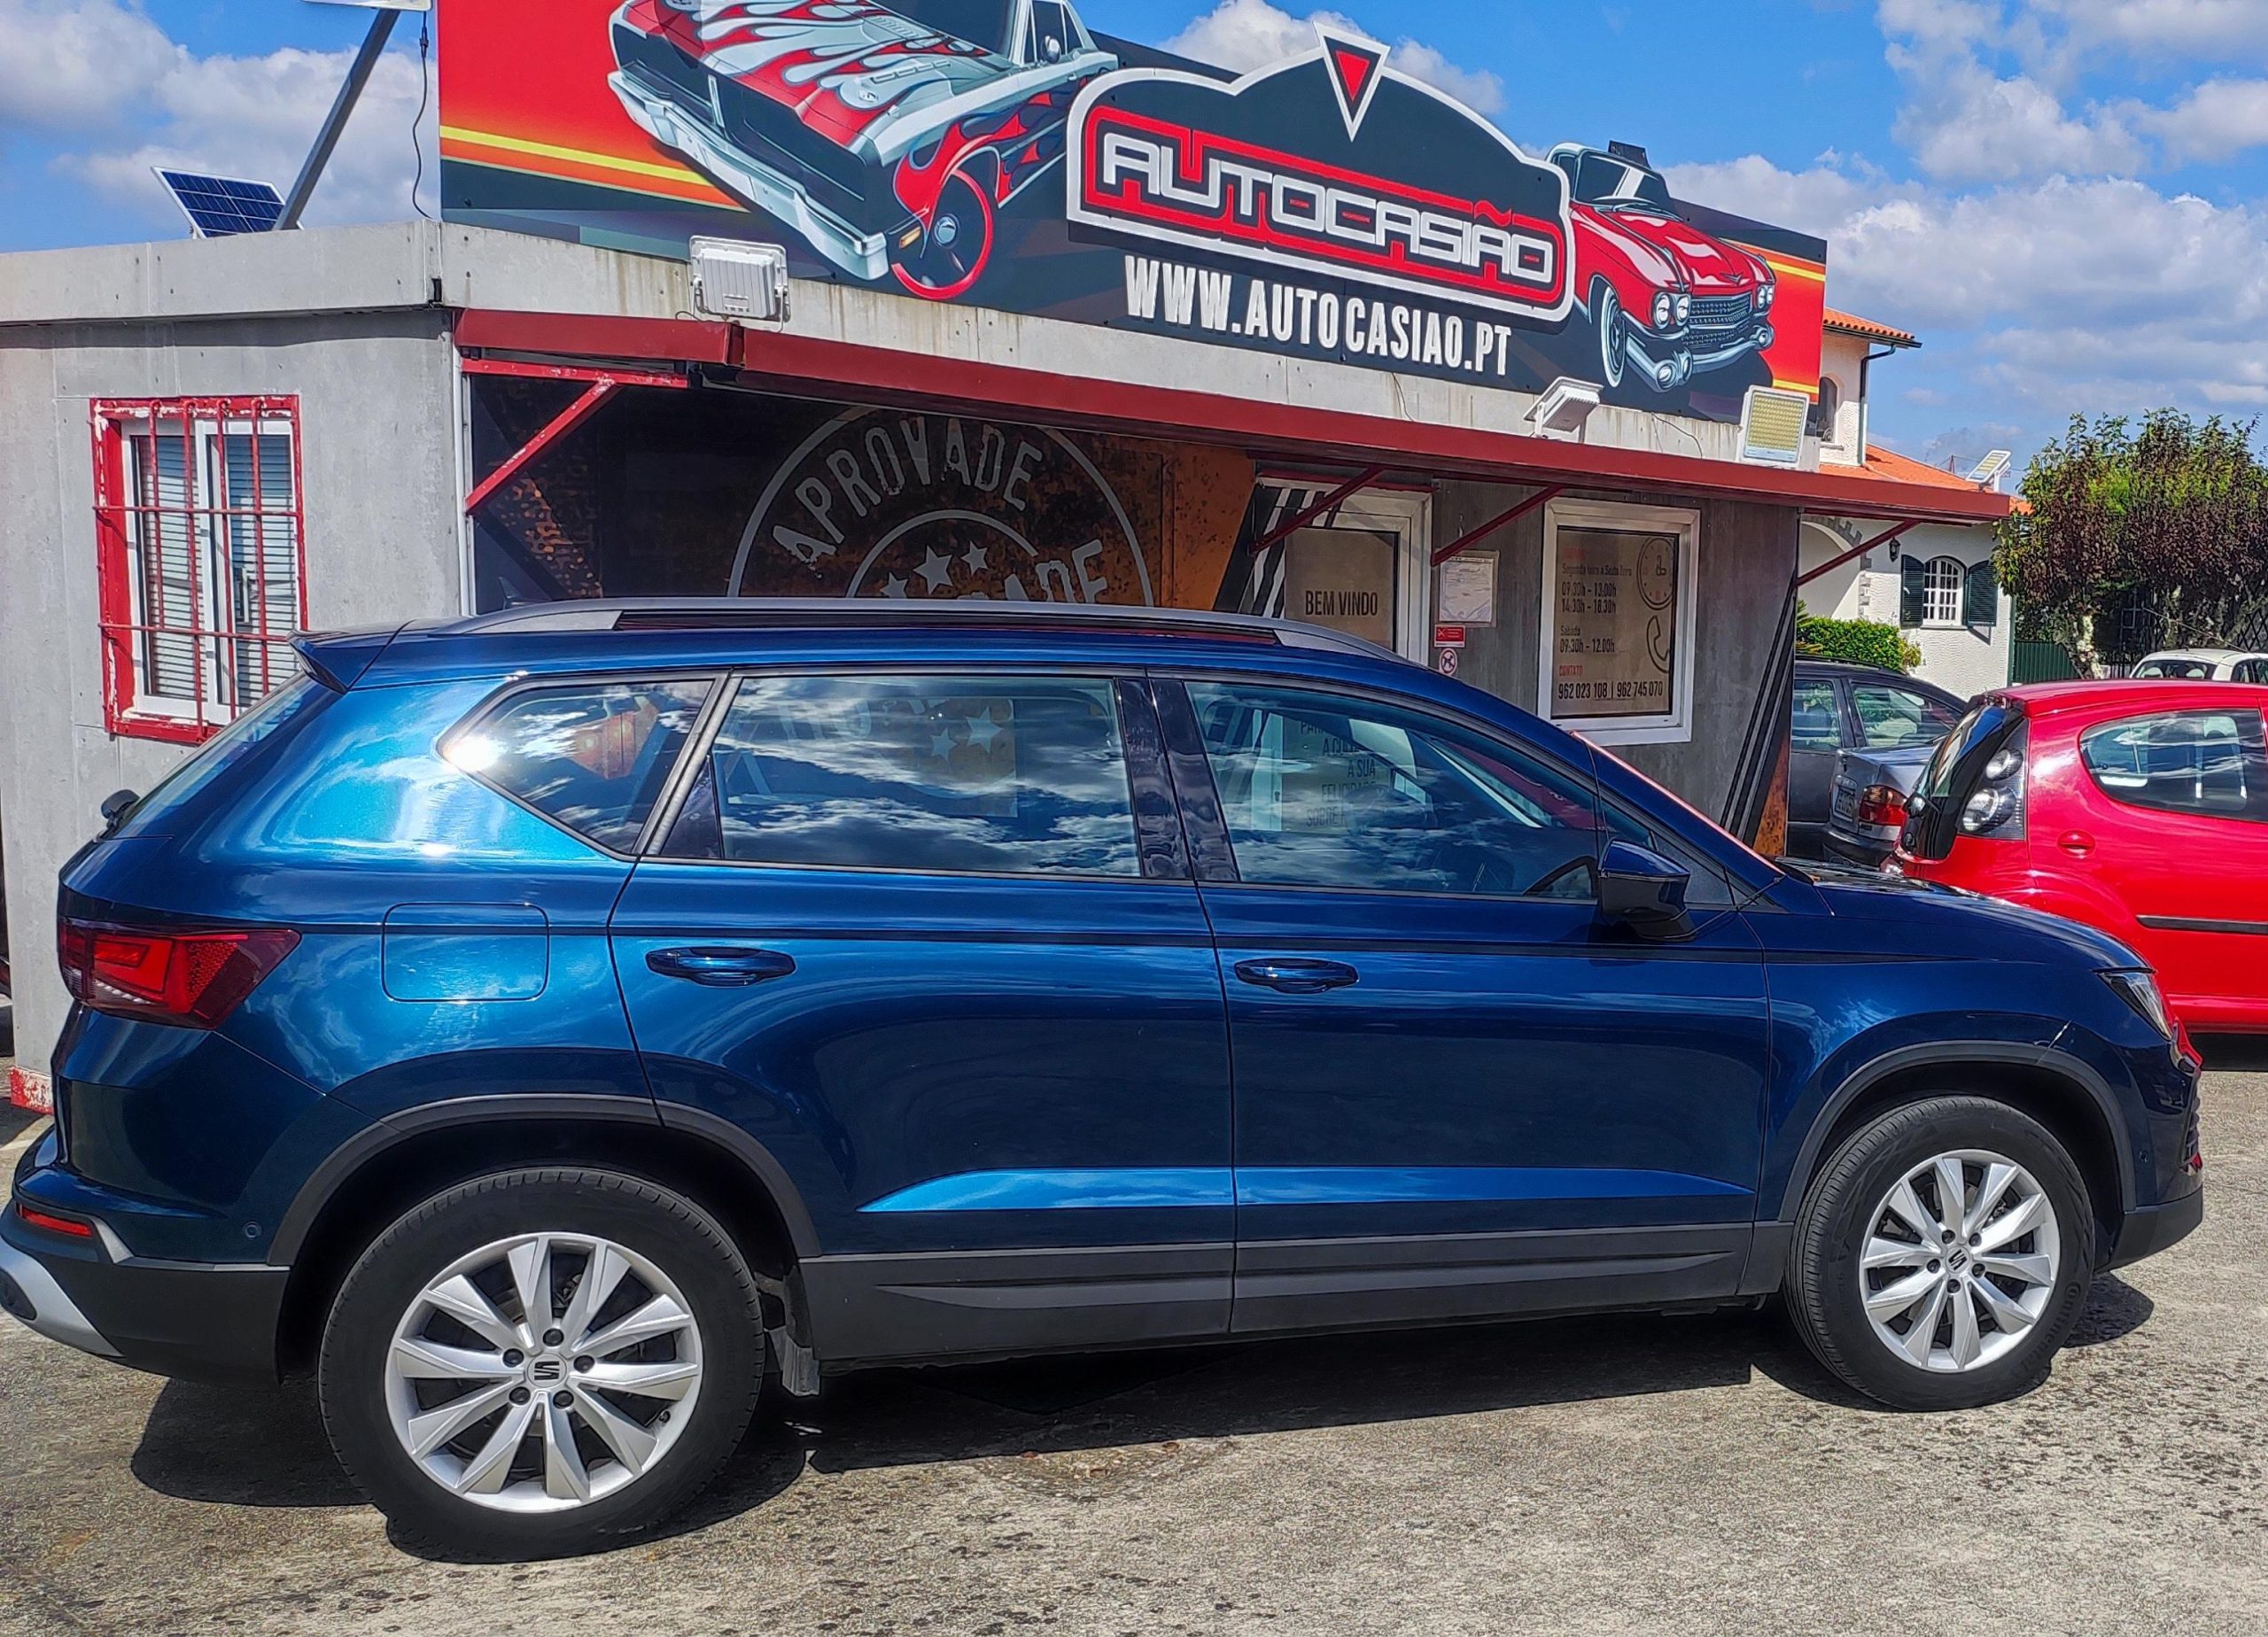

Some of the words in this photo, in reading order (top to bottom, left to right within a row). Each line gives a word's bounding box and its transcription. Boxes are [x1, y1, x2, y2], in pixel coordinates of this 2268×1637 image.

[1103, 132, 1554, 284] AUTOCASIÃO
[1124, 255, 1511, 376] WWW.AUTOCASIAO.PT
[773, 416, 1043, 578] APROVADE
[1305, 590, 1335, 616] BEM
[1339, 591, 1379, 617] VINDO
[1557, 683, 1574, 700] 962
[1575, 682, 1591, 698] 023
[1593, 681, 1608, 698] 108
[1616, 681, 1632, 697] 962
[1634, 681, 1648, 697] 745
[1649, 680, 1664, 696] 070
[1356, 758, 1376, 778] SUA
